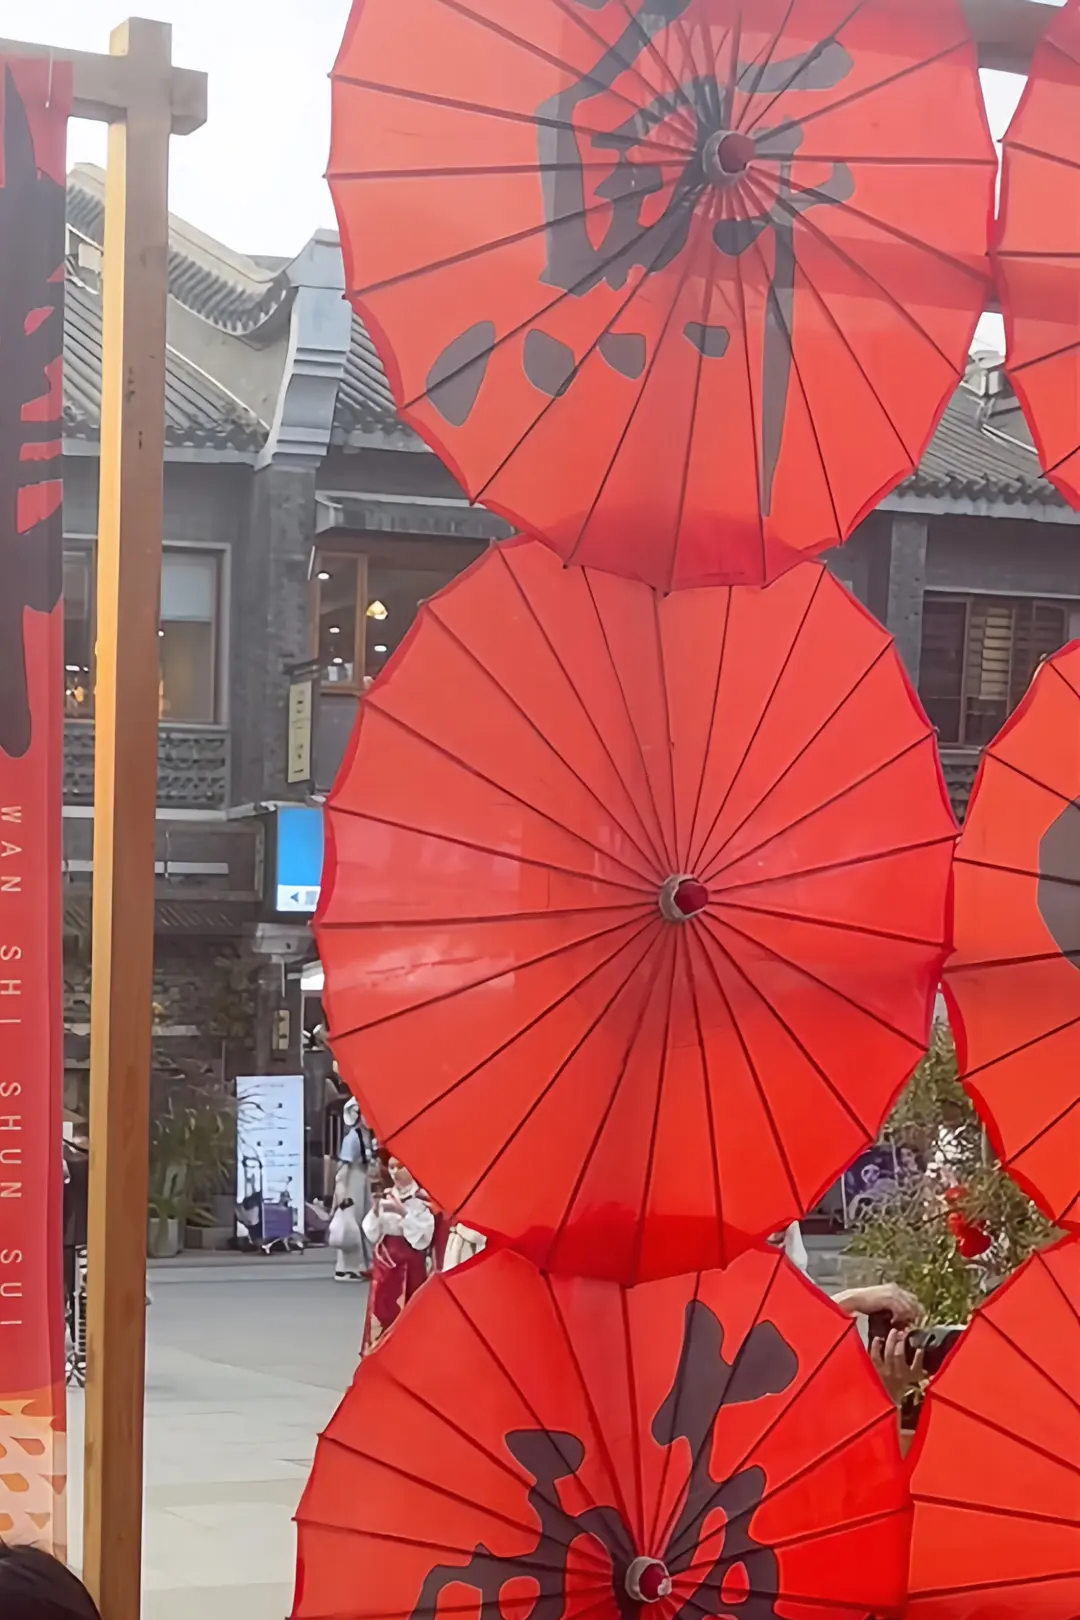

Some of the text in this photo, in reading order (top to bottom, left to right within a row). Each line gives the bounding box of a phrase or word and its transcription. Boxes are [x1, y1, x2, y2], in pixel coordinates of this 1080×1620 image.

[0, 806, 22, 1325] WAN SHI SHUN SUI
